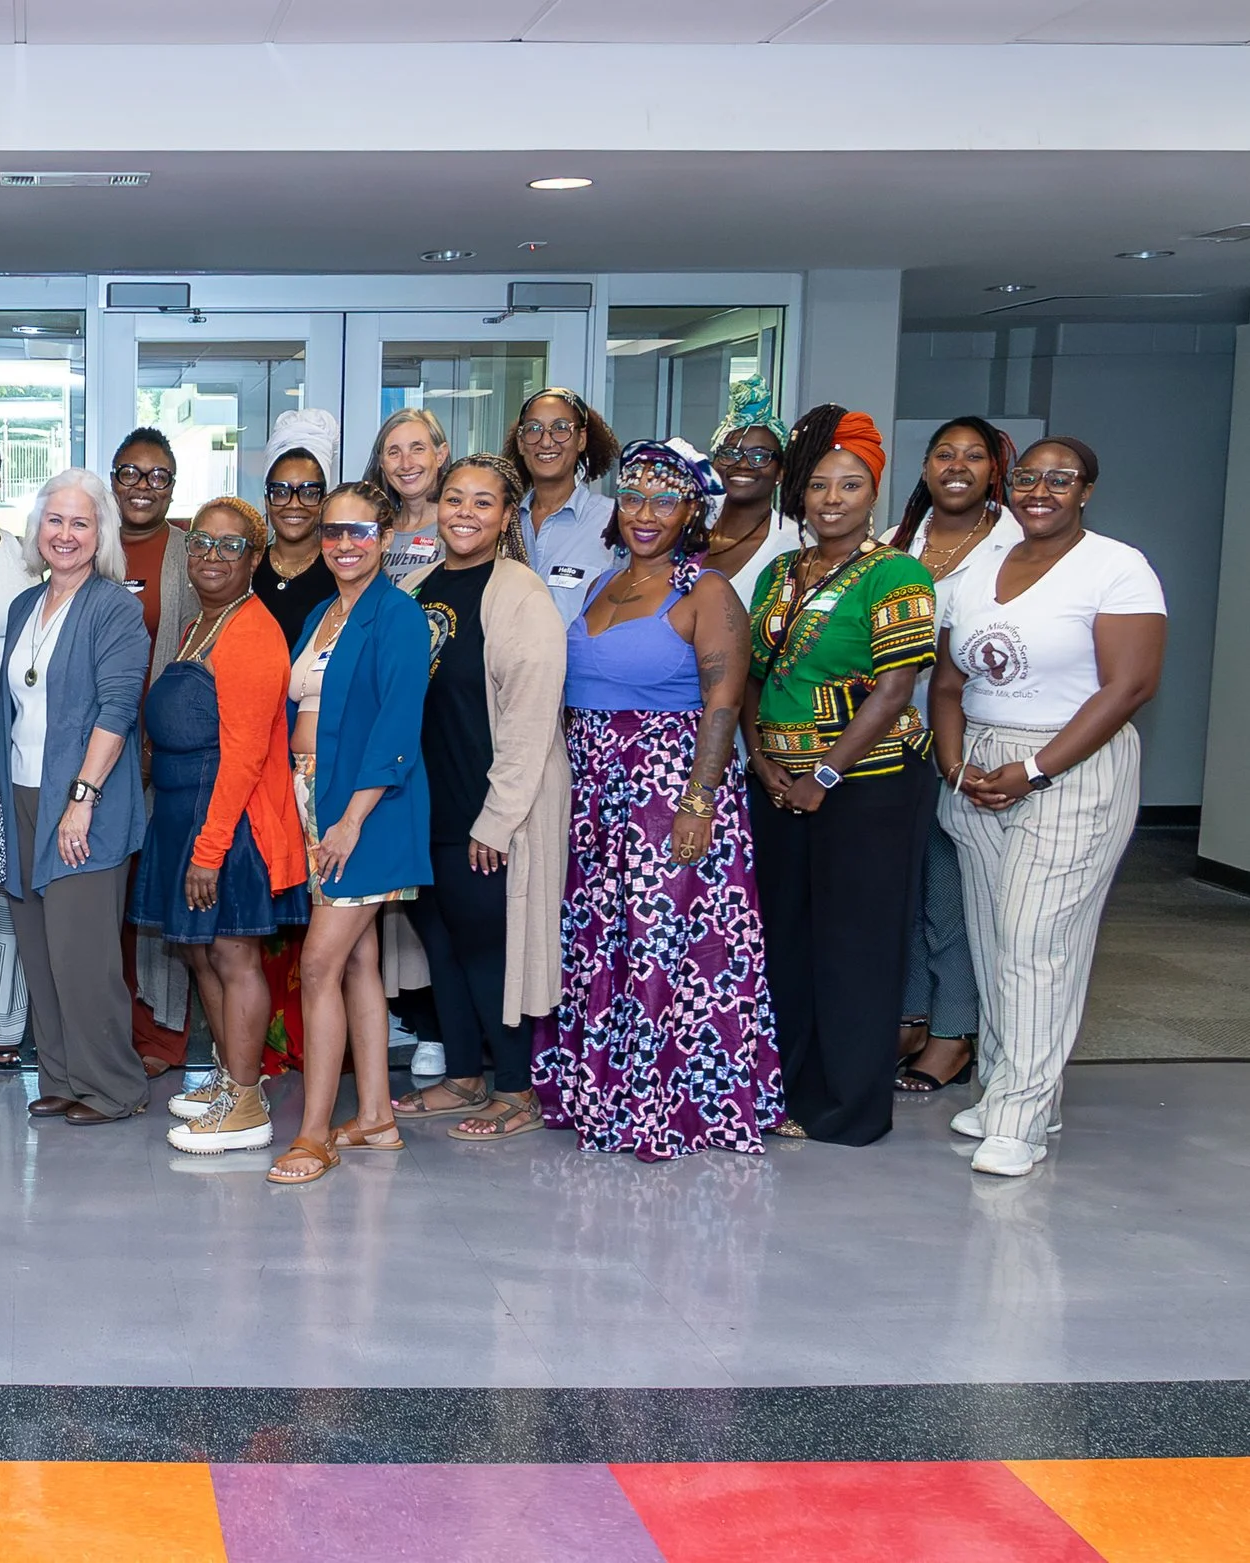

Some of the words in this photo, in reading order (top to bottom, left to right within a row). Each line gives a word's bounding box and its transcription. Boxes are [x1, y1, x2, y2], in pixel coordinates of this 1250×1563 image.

[558, 566, 577, 575] Hello
[958, 629, 985, 656] Vessels
[986, 621, 1023, 644] Midwifery
